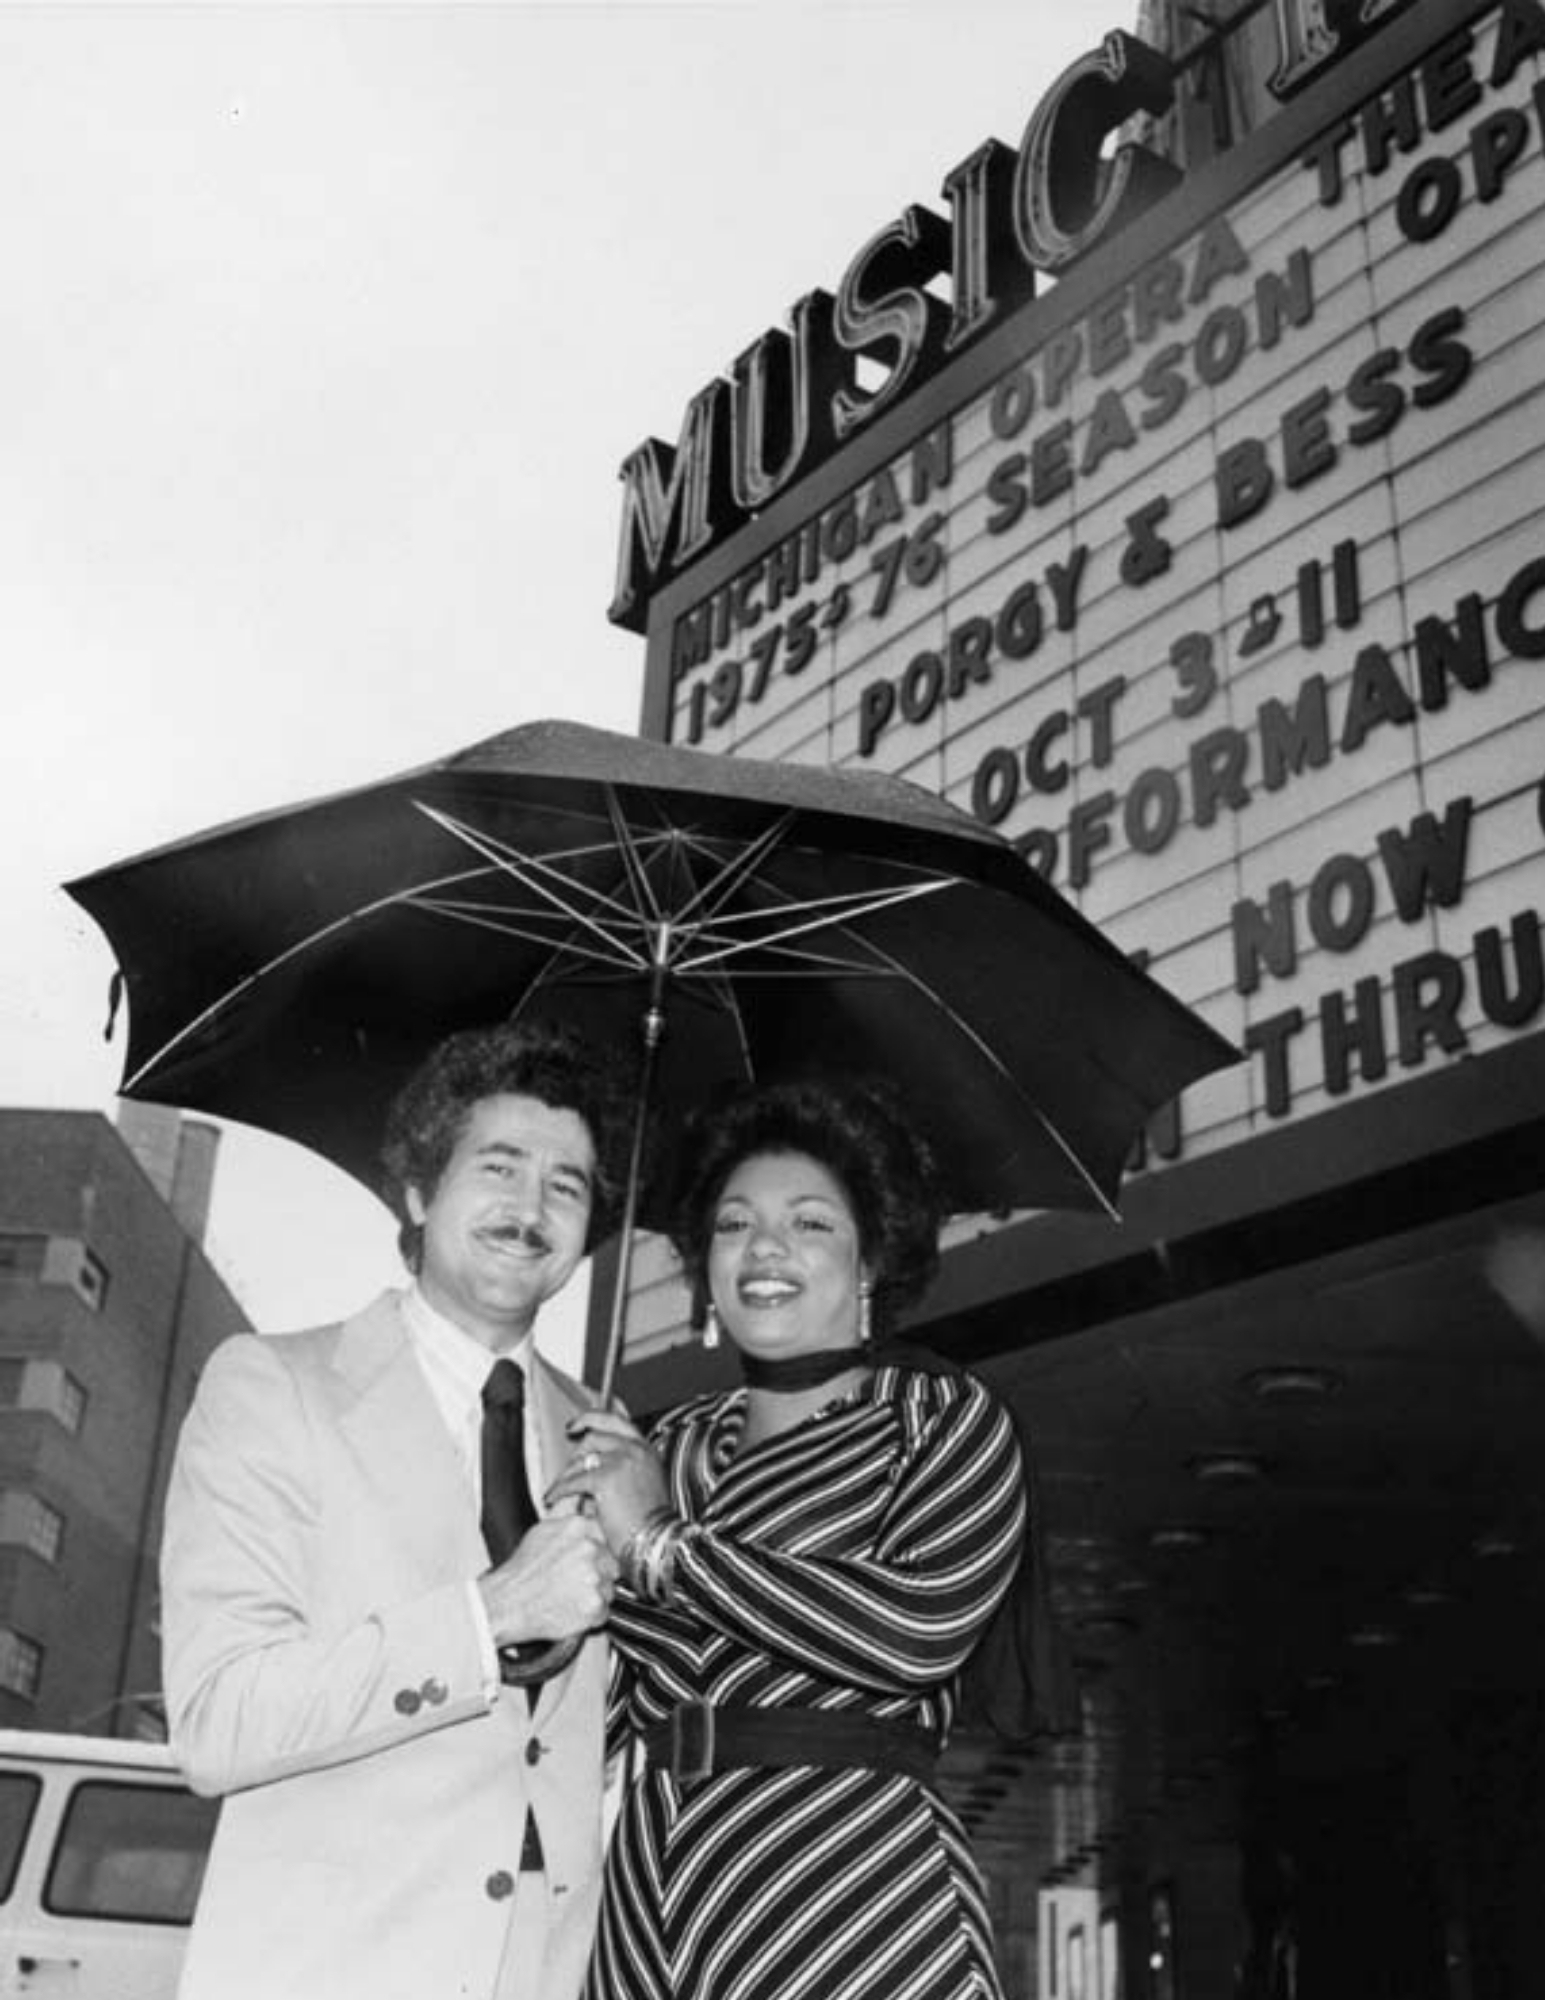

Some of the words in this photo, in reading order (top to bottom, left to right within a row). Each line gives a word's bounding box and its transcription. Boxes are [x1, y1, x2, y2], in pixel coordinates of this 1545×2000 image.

[607, 28, 1176, 634] MUSIC
[673, 418, 953, 684] MICHIGAN
[990, 214, 1249, 441] OPERA
[858, 544, 1088, 758] PORGY
[1119, 493, 1174, 586] &
[1215, 304, 1475, 532] BESS
[985, 246, 1316, 536] SEASON
[1396, 80, 1545, 244] OP
[971, 674, 1127, 825] OCT
[1231, 795, 1474, 996] NOW
[1247, 908, 1545, 1119] THRU
